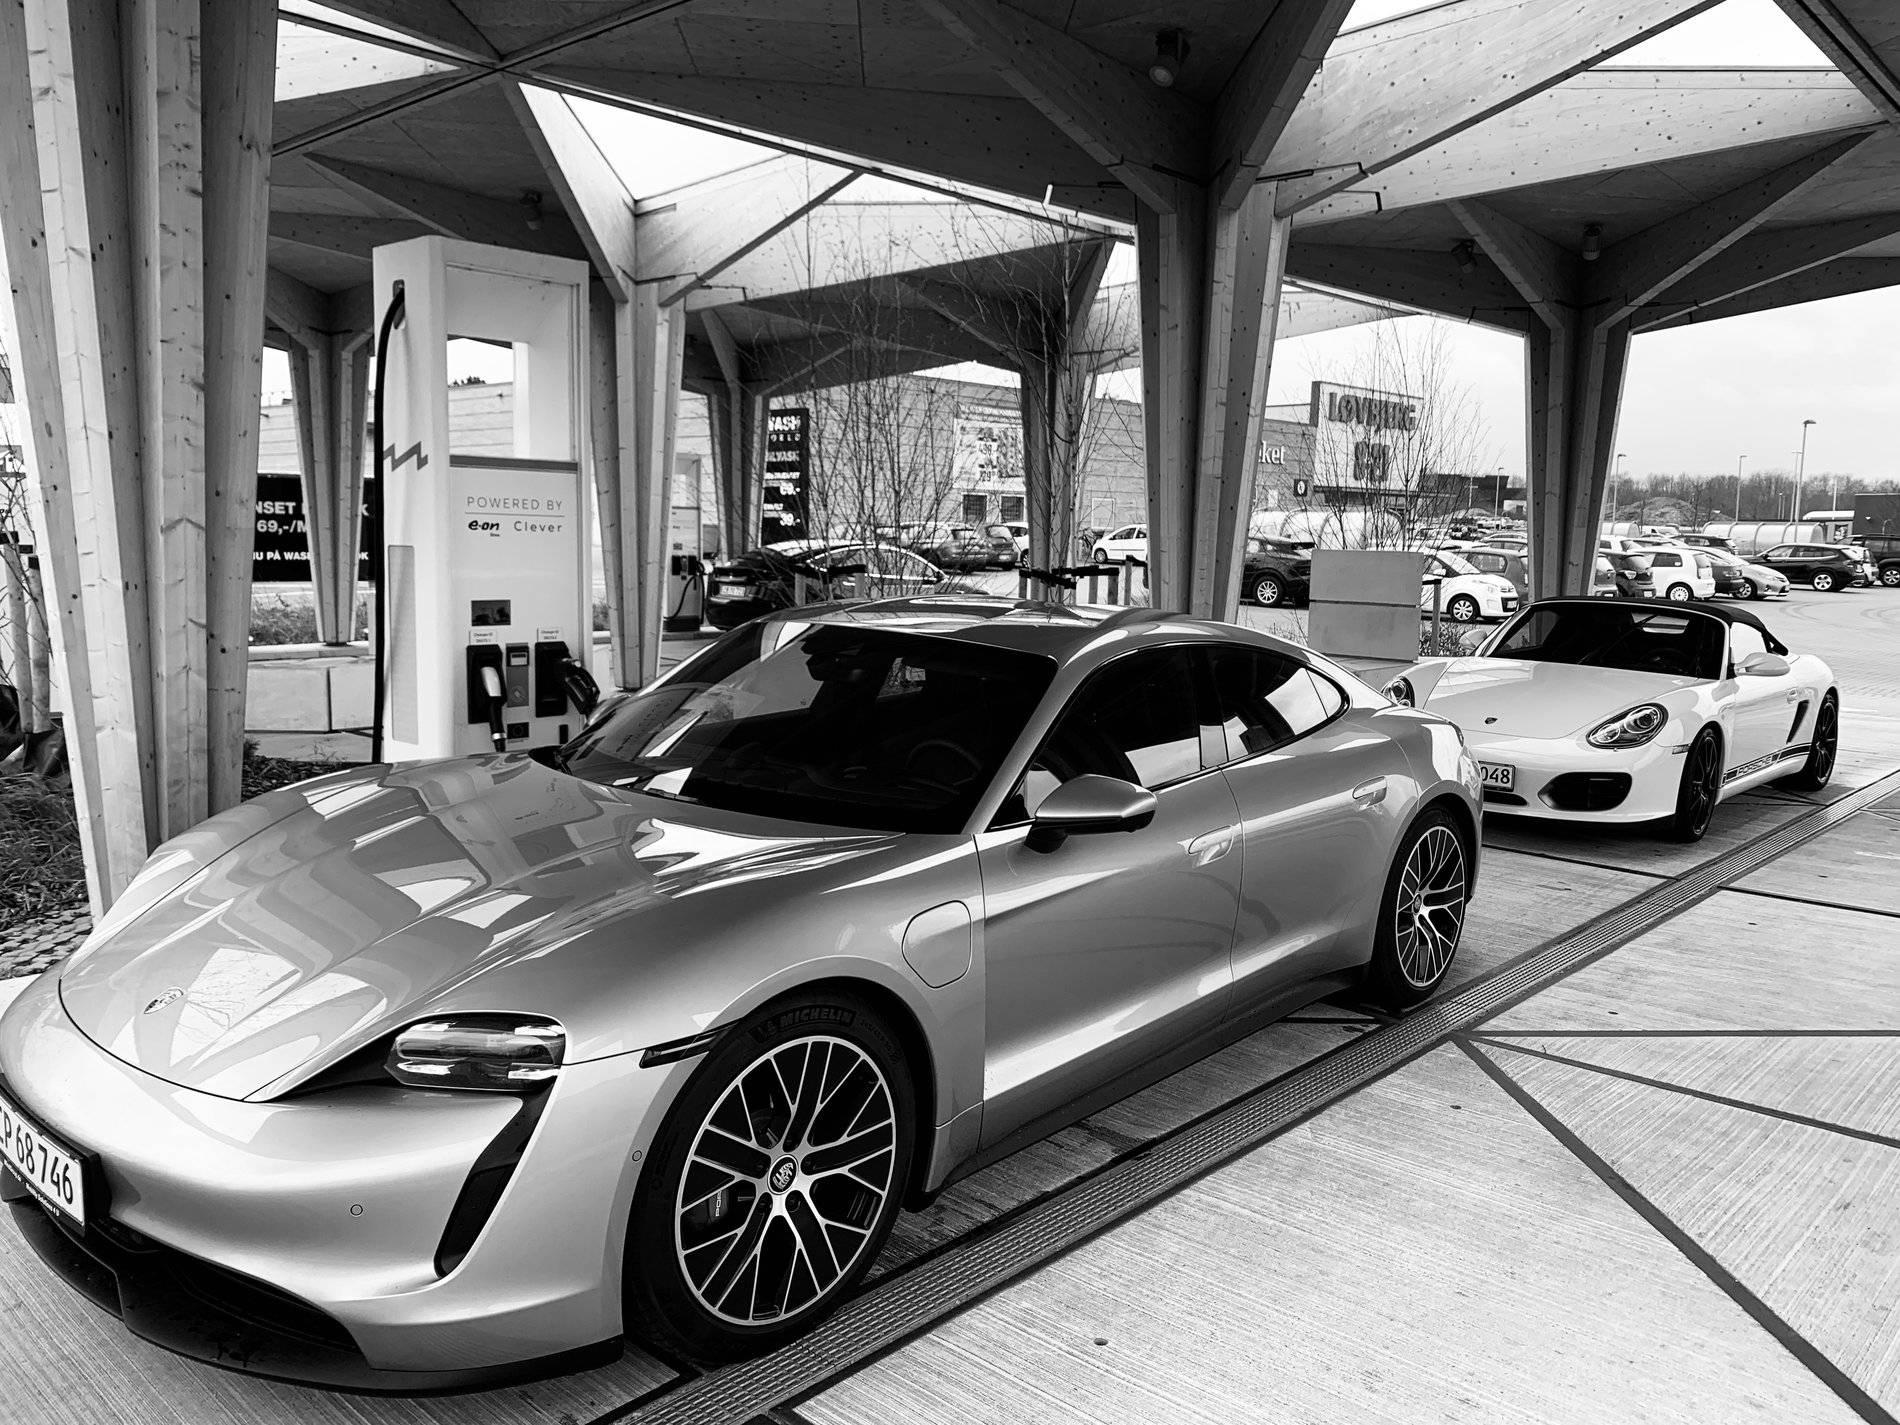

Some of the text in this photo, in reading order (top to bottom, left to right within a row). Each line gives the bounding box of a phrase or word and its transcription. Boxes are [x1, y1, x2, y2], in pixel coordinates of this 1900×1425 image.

[256, 501, 296, 515] NSET
[467, 496, 562, 511] POWERED BY
[513, 520, 562, 533] Clever
[266, 549, 282, 561] PÅ
[780, 1007, 855, 1028] MICHELIN
[0, 1105, 12, 1149] P
